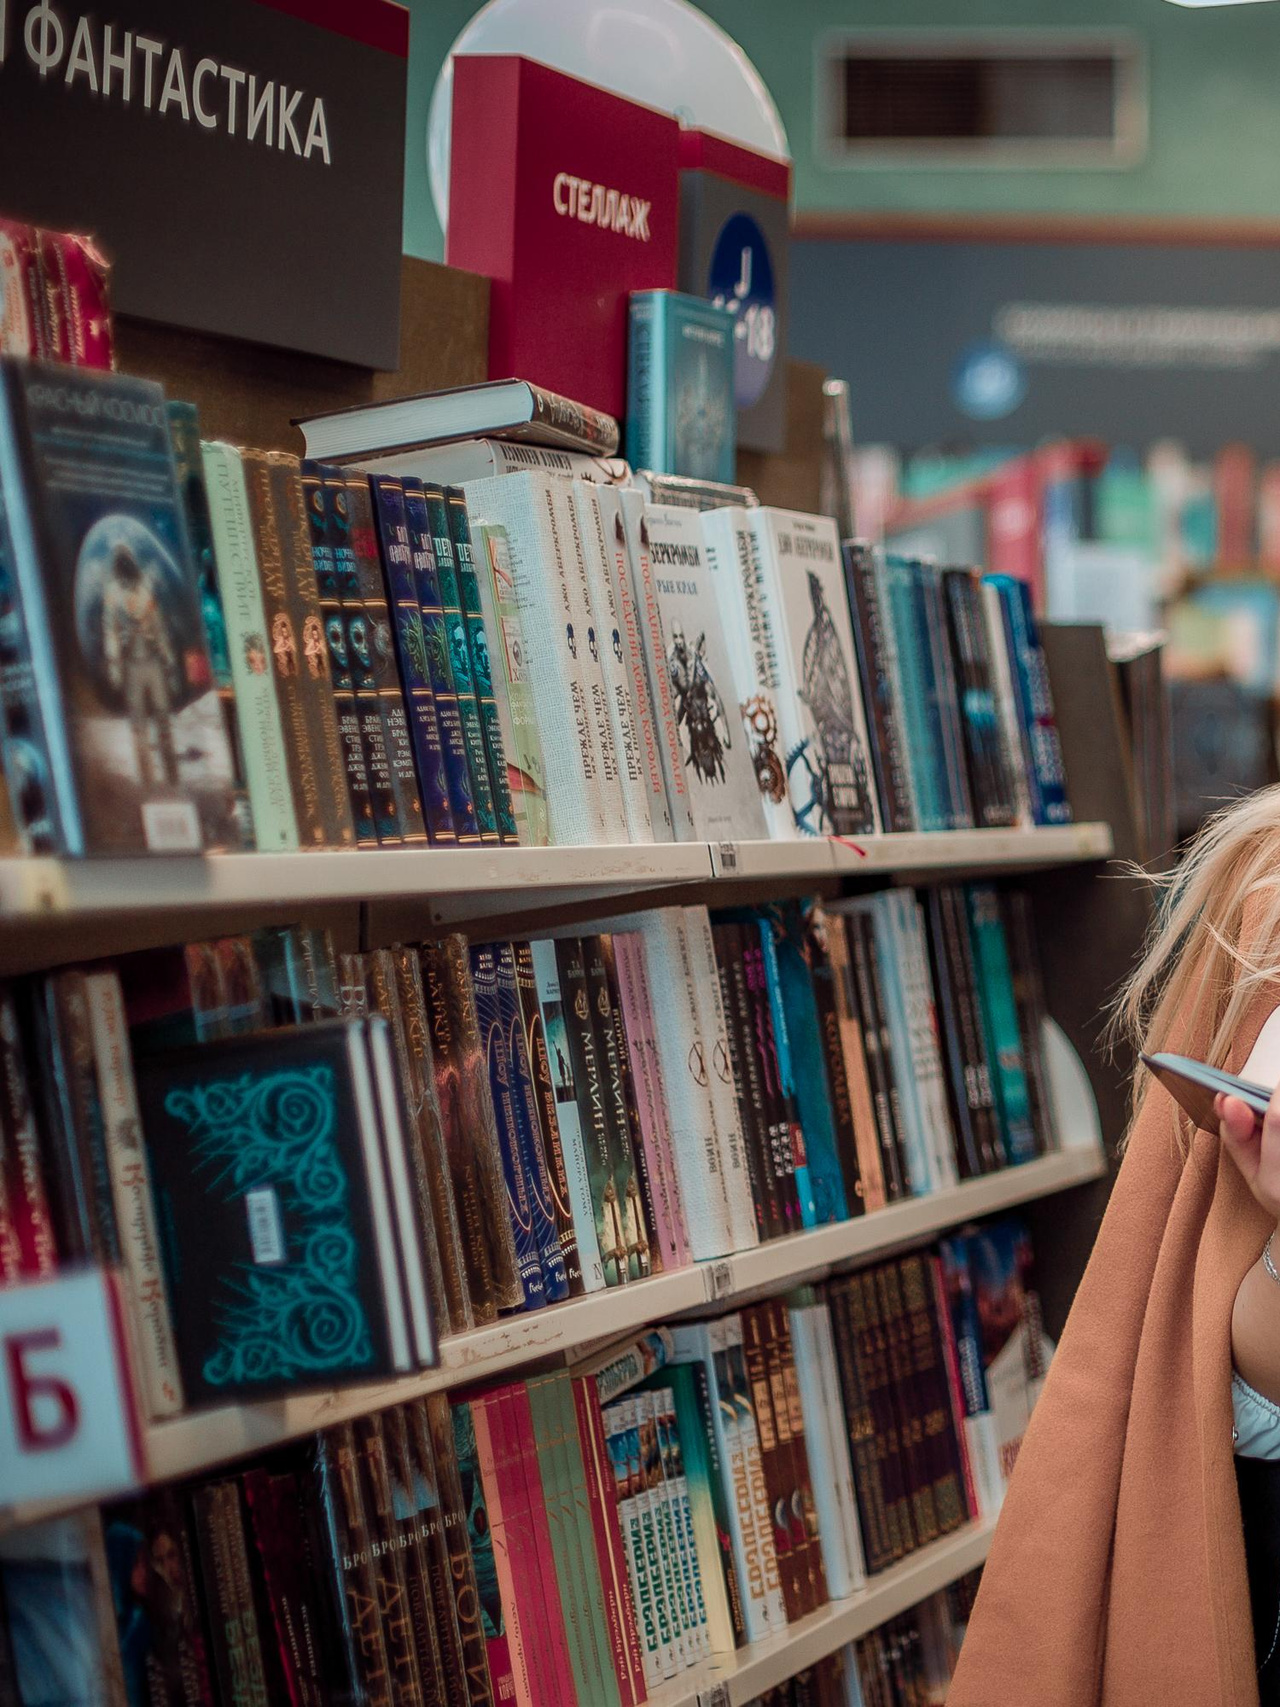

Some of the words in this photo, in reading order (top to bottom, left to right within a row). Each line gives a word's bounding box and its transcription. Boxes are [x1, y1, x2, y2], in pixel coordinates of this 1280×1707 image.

[24, 0, 331, 165] ФАНТАСТИКА
[553, 172, 652, 242] СТЕЛЛАЖ
[545, 489, 565, 579] АБЕРКРОМБИ
[567, 495, 586, 584] АБЕРКРОМБИ
[591, 499, 610, 586] АБЕРКРОМБИ
[571, 681, 582, 713] ЧЕМ
[592, 684, 602, 716] ЧЕМ
[615, 553, 639, 660] ПОСЛЕДНИЙ
[631, 661, 648, 716] ДОВОД
[642, 719, 662, 793] КОРОЛЕЙ
[615, 684, 626, 717] ЧЕМ
[640, 556, 664, 664] ПОСЛЕДНИЙ
[655, 664, 671, 716] ДОВОД
[664, 720, 685, 794] КОРОЛЕЙ
[577, 716, 592, 780] ПРЕЖДЕ
[598, 719, 613, 782] ПРЕЖДЕ
[622, 721, 638, 781] ПРЕЖДЕ
[428, 971, 448, 1056] БАРКЕР
[613, 1008, 627, 1060] ВТОРОЙ
[494, 1040, 510, 1088] ШОУ
[515, 1033, 530, 1081] ШОУ
[581, 1032, 604, 1129] МЕРЛИН
[604, 1029, 625, 1125] МЕРЛИН
[536, 1037, 551, 1087] ШОУ
[544, 1091, 567, 1198] БЕЗЛИКИХ
[572, 1138, 583, 1180] МАЙОРА
[579, 1184, 589, 1217] ТОМА
[704, 1137, 717, 1174] ВОИН
[728, 1132, 740, 1169] ВОИН
[5, 1327, 82, 1455] Б
[451, 1553, 490, 1704] БОГИ
[609, 1590, 623, 1652] Брэдбери
[622, 1583, 637, 1647] Брэдбери
[617, 1656, 627, 1681] Рэй
[632, 1650, 642, 1675] Рэй
